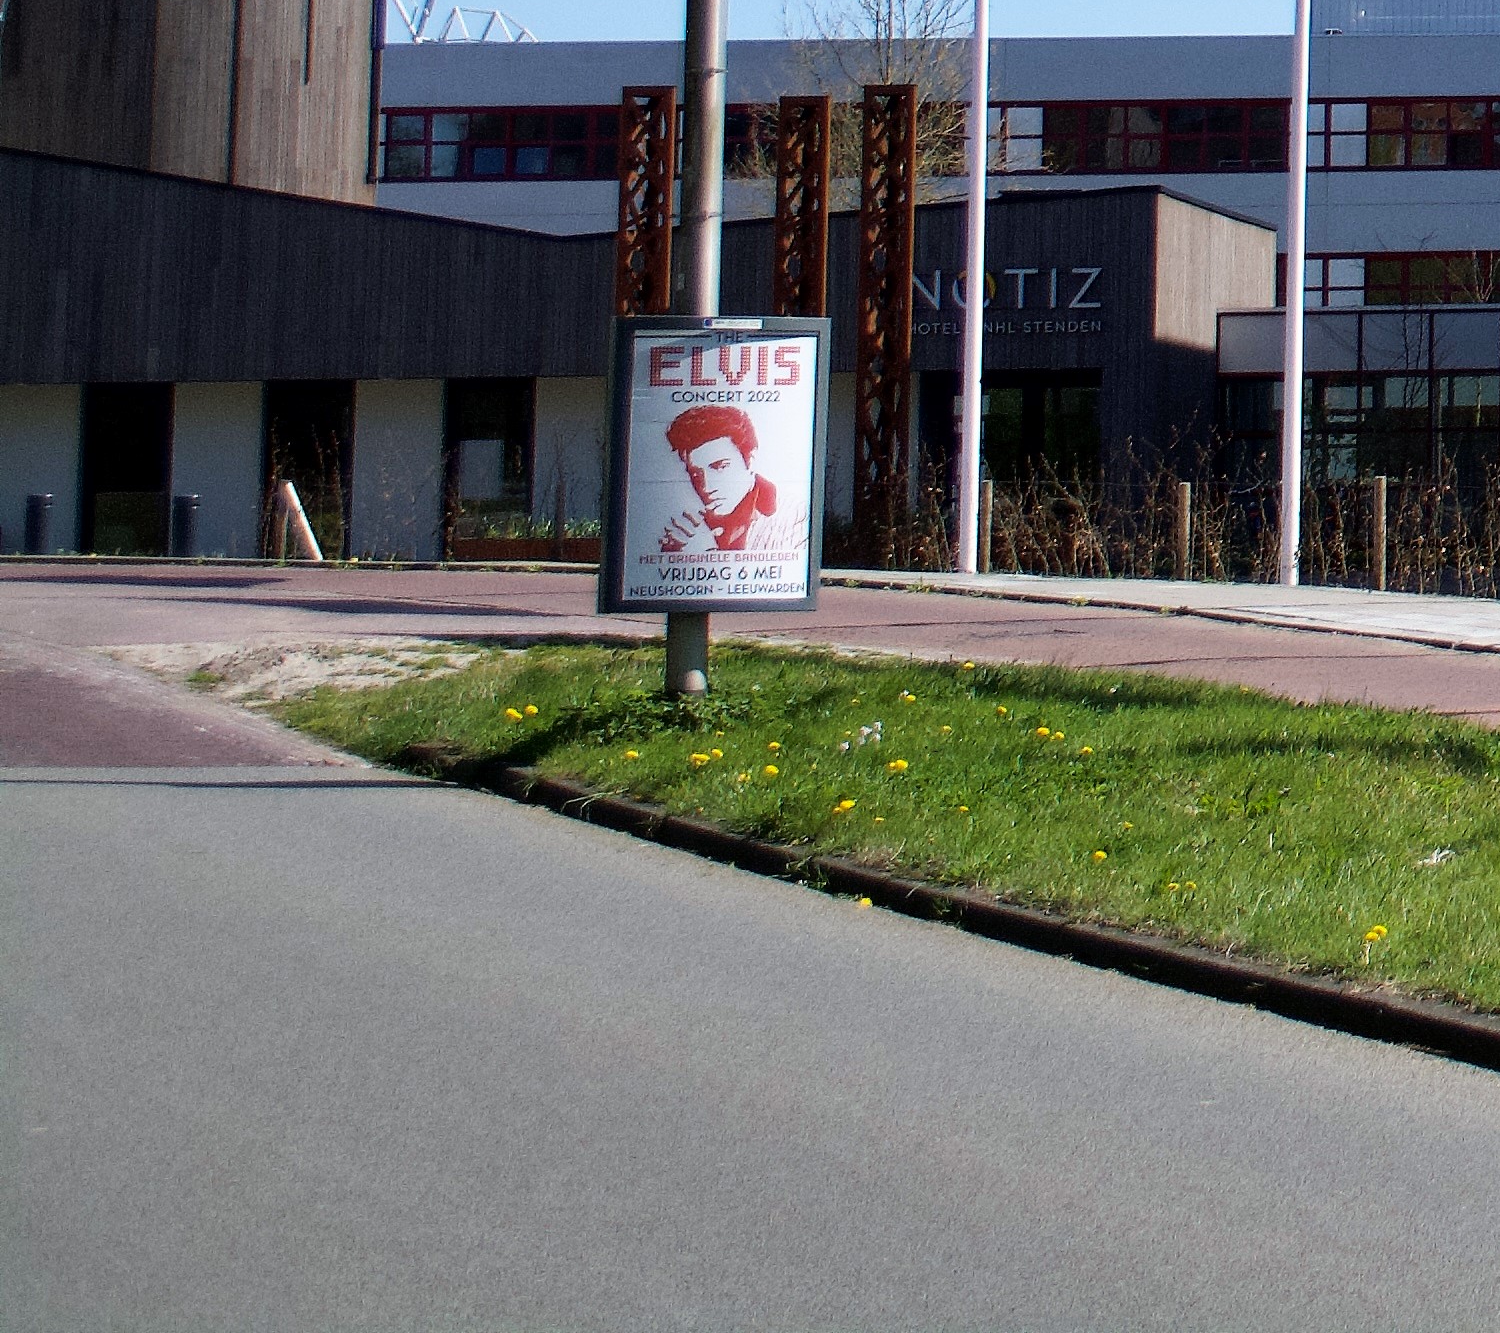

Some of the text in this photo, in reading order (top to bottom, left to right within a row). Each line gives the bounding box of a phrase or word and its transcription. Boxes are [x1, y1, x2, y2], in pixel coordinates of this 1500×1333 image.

[984, 321, 1015, 334] NHL
[1023, 320, 1102, 334] STENDEN
[715, 332, 744, 343] THE
[650, 346, 800, 386] ELVIS
[671, 390, 780, 403] CONCERT 2022
[639, 552, 799, 564] MET ORIGINELE BANDLEDEN
[658, 565, 782, 582] VRIJDAG 6 MEI
[629, 585, 714, 597] NEUSHOORN
[727, 582, 805, 595] LEEUWARDEN
